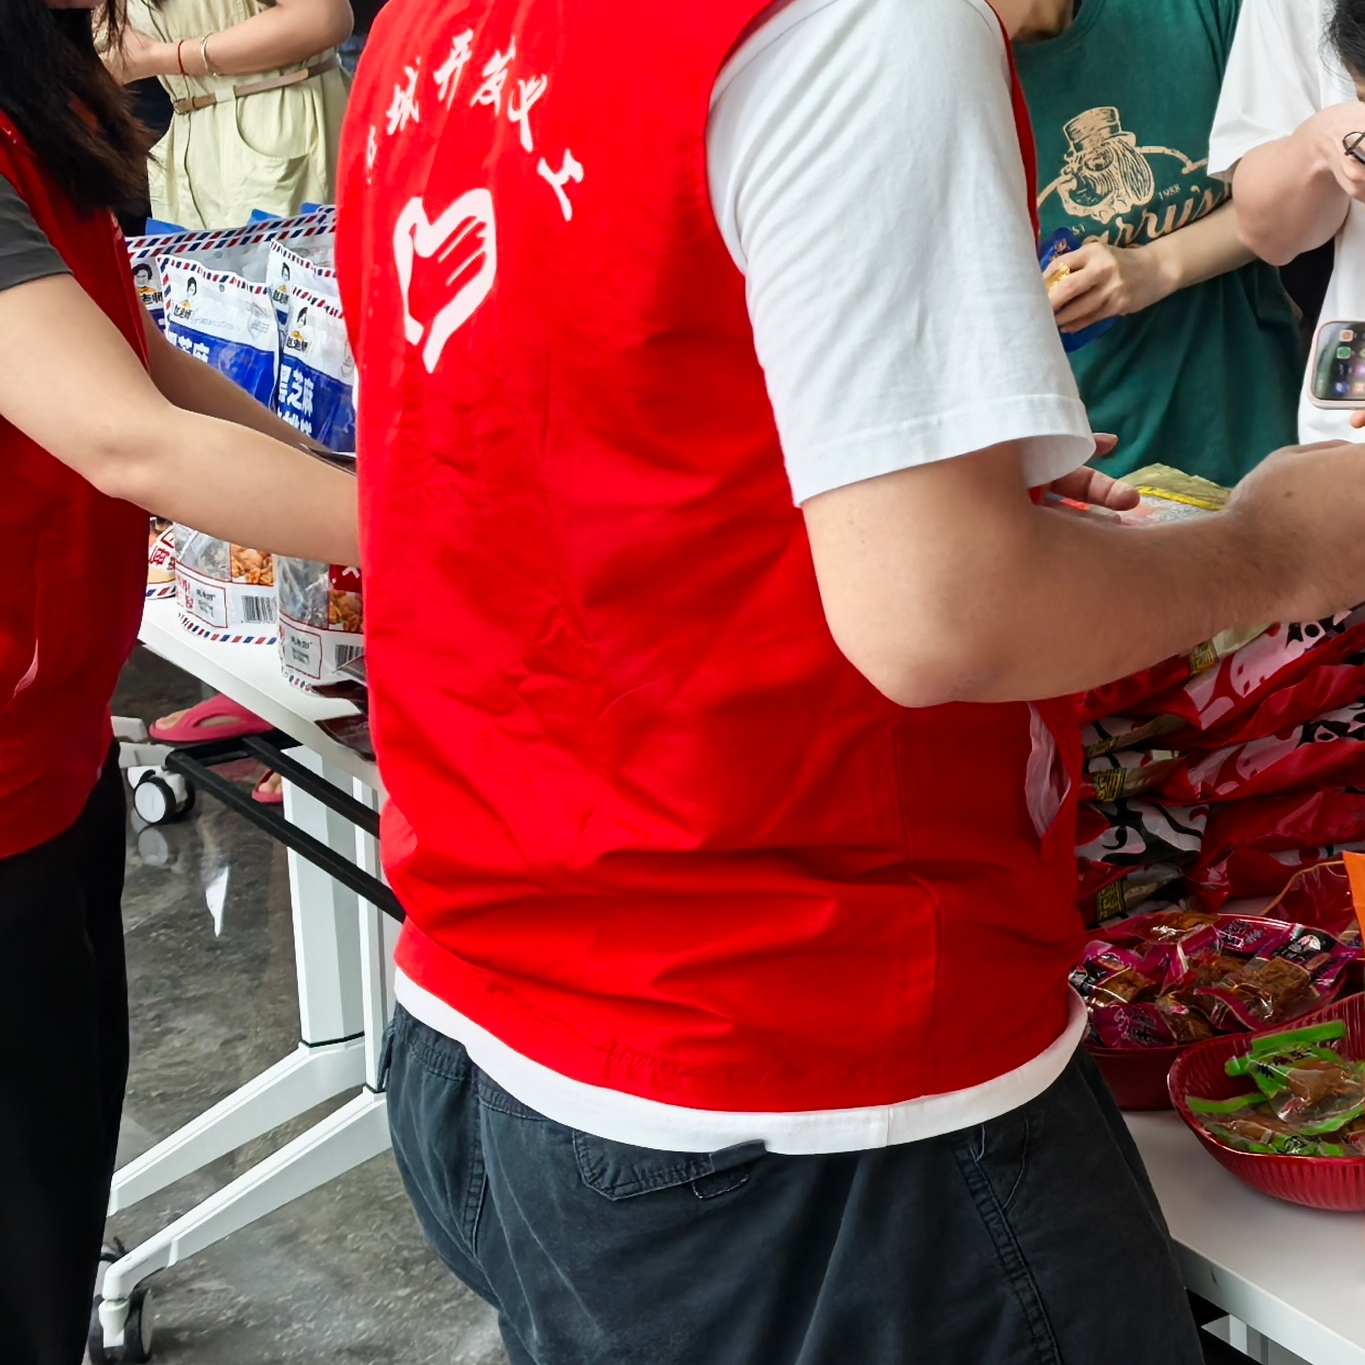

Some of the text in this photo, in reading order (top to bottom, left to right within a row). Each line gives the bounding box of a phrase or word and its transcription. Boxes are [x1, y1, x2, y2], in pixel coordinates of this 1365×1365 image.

[140, 291, 163, 306] 老师
[278, 363, 314, 418] 黑芝麻
